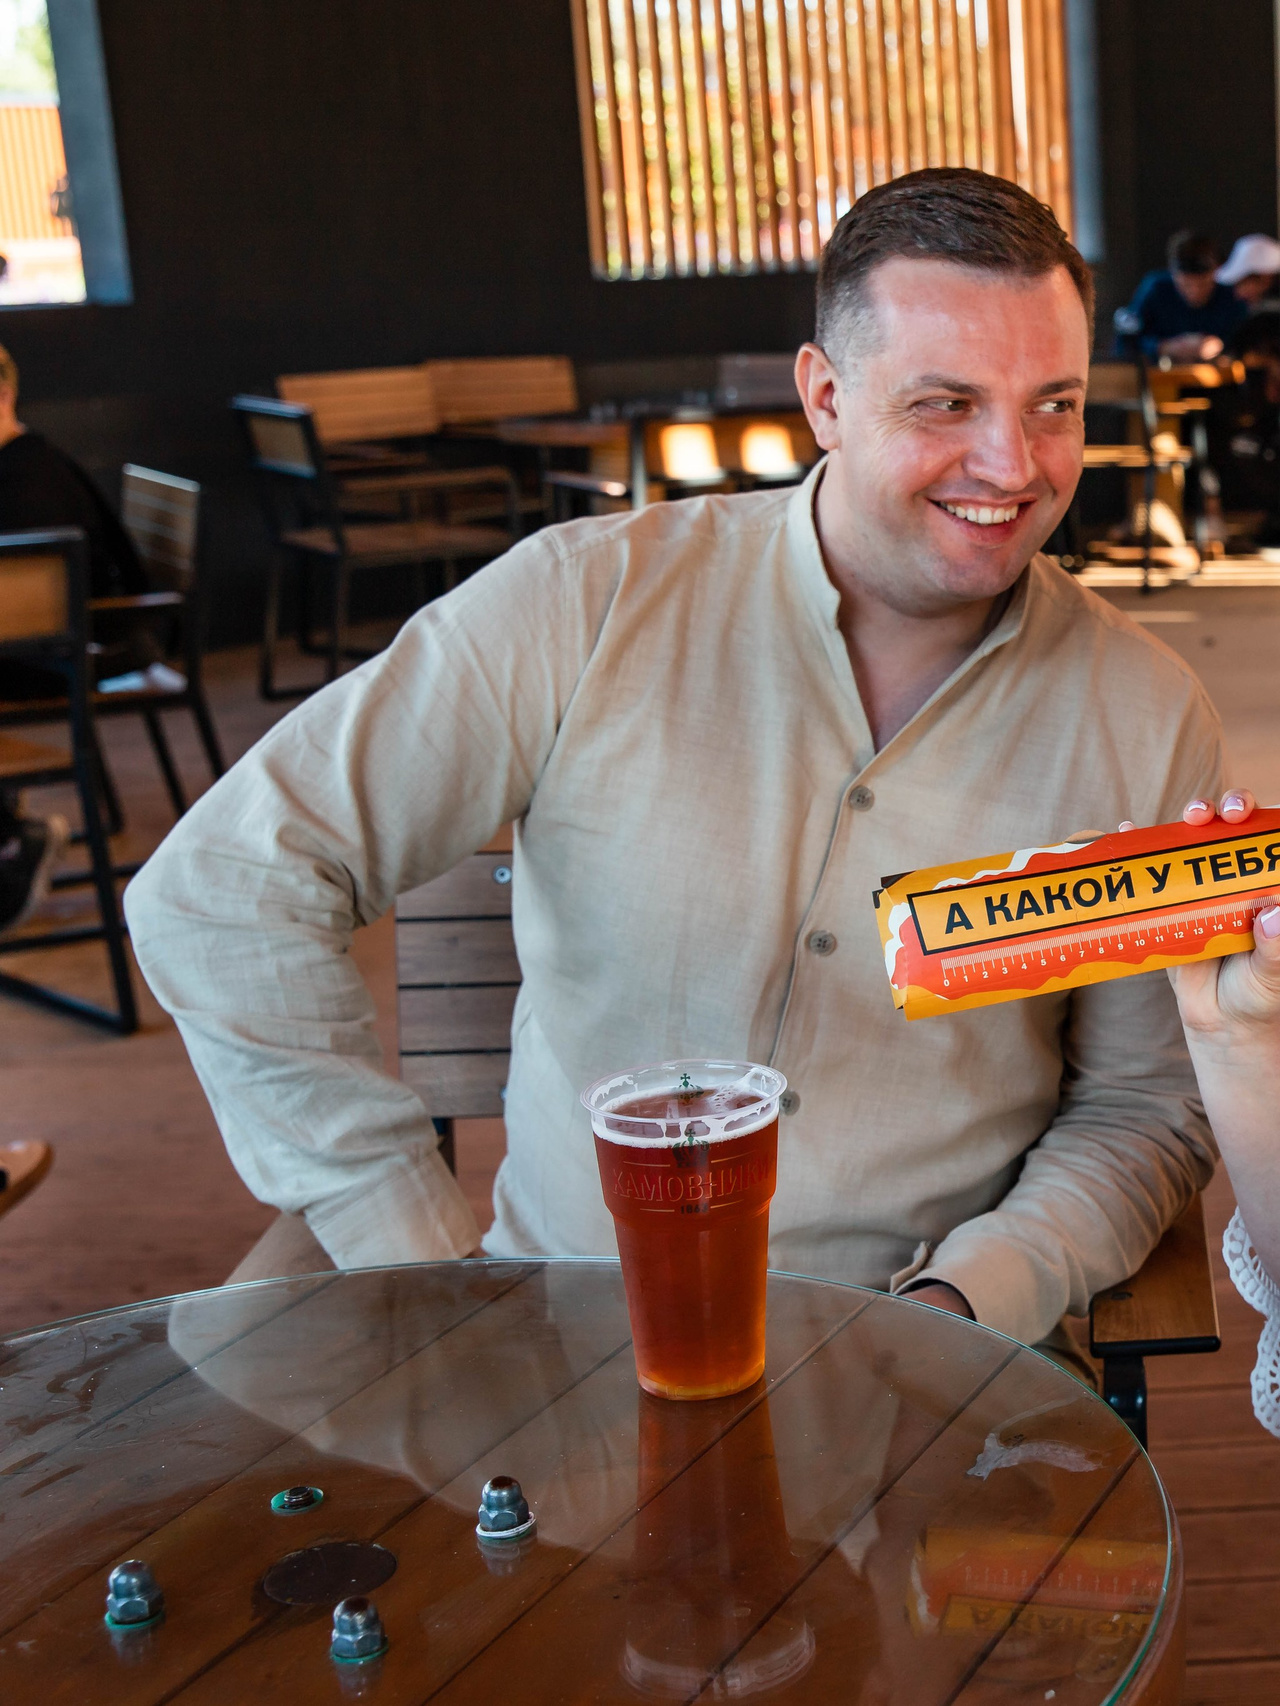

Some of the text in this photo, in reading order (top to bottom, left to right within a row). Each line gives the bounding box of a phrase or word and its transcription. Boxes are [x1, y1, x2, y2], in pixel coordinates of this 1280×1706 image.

[945, 902, 974, 935] А
[984, 865, 1135, 926] КАКОЙ
[1145, 862, 1171, 894] У
[943, 978, 950, 987] 0
[962, 974, 969, 983] 1
[981, 970, 989, 979] 2
[1001, 966, 1009, 975] 3
[1020, 962, 1028, 970] 4
[1040, 958, 1047, 967] 5
[1059, 954, 1067, 962] 6
[1078, 950, 1086, 958] 7
[1098, 946, 1105, 955] 8
[1117, 942, 1124, 951] 9
[1134, 939, 1146, 948] 10
[1154, 935, 1165, 943] 11
[1173, 931, 1185, 940] 12
[1192, 927, 1204, 936] 13
[1212, 923, 1224, 931] 14
[1231, 919, 1243, 928] 15
